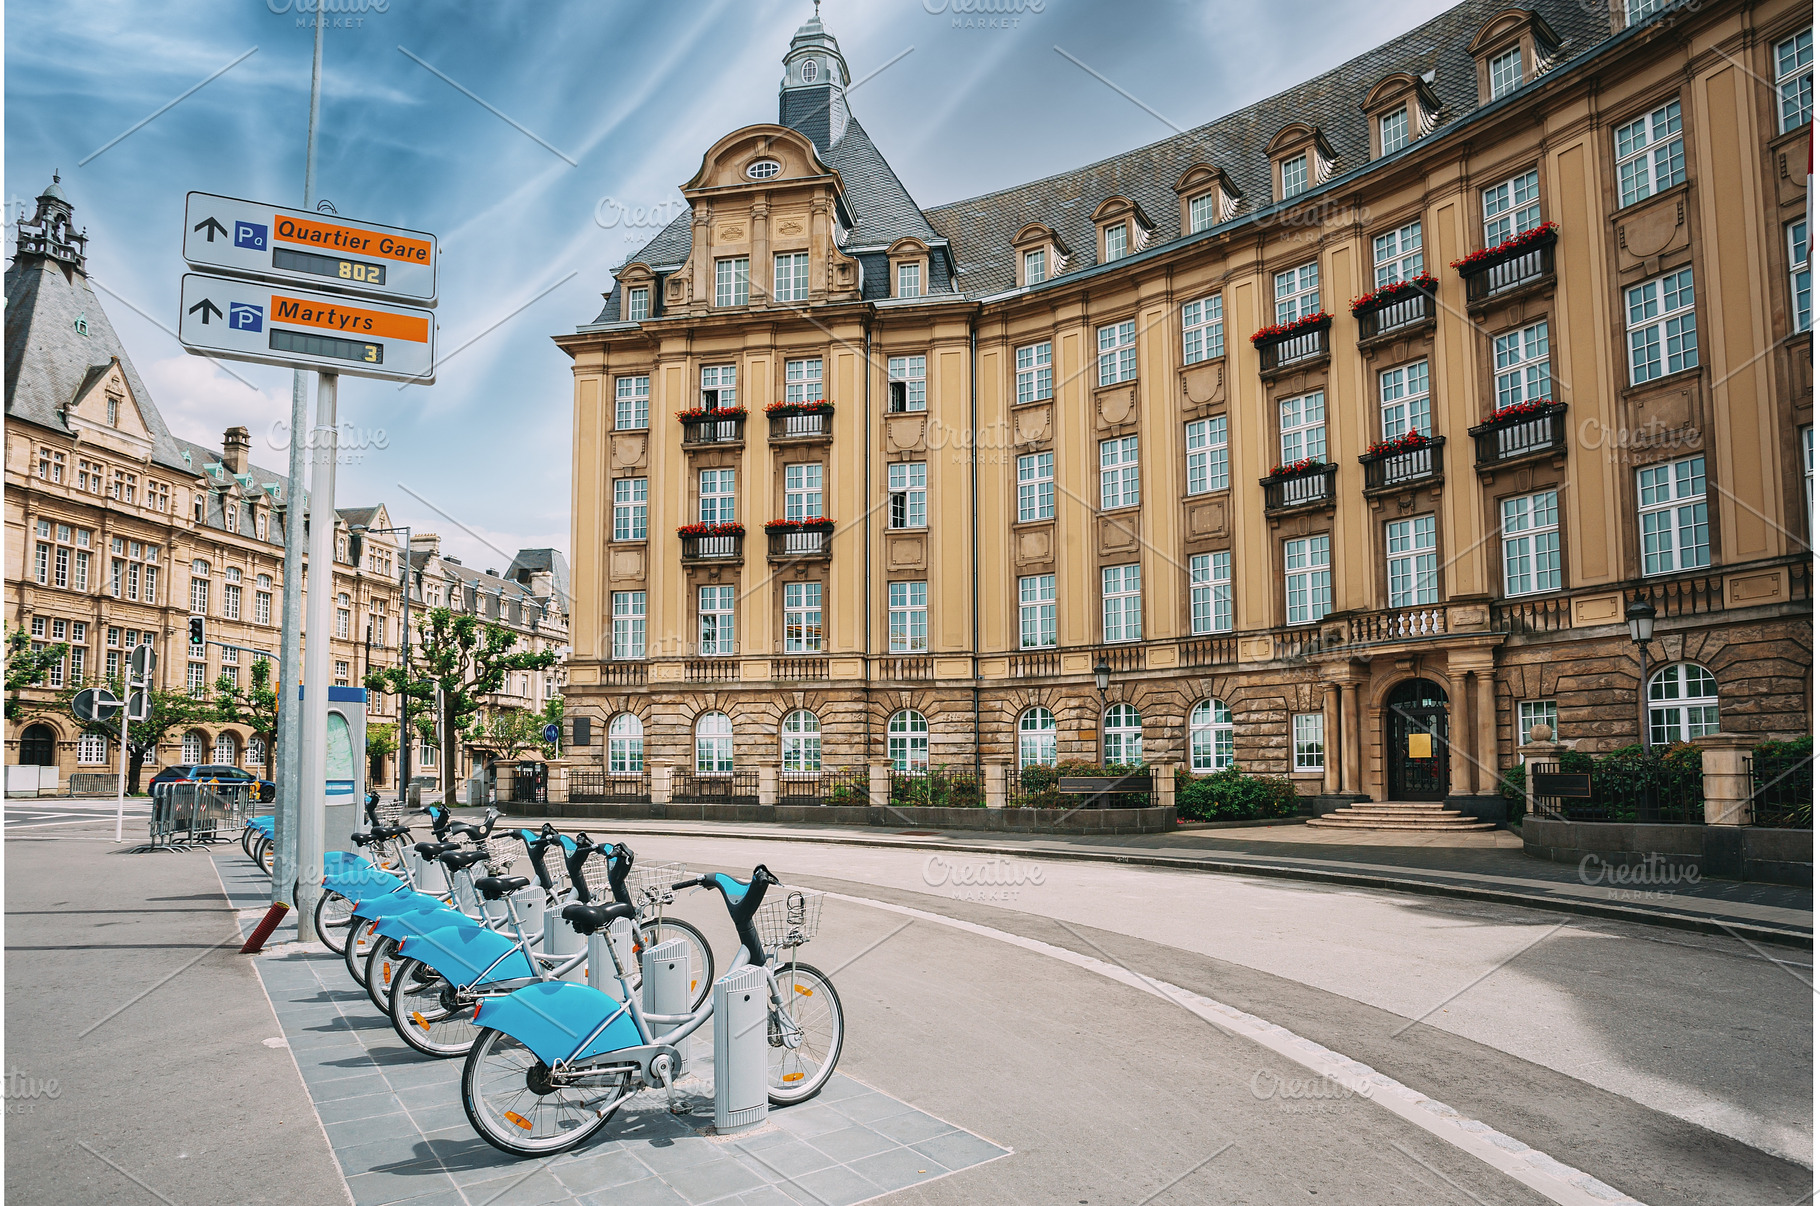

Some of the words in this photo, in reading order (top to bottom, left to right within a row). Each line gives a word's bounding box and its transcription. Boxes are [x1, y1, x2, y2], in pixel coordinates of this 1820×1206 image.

[278, 220, 371, 250] Quartier
[379, 238, 427, 260] Gare
[339, 261, 380, 284] 802
[238, 312, 254, 329] P
[277, 301, 373, 330] Martyrs
[364, 345, 377, 362] 3
